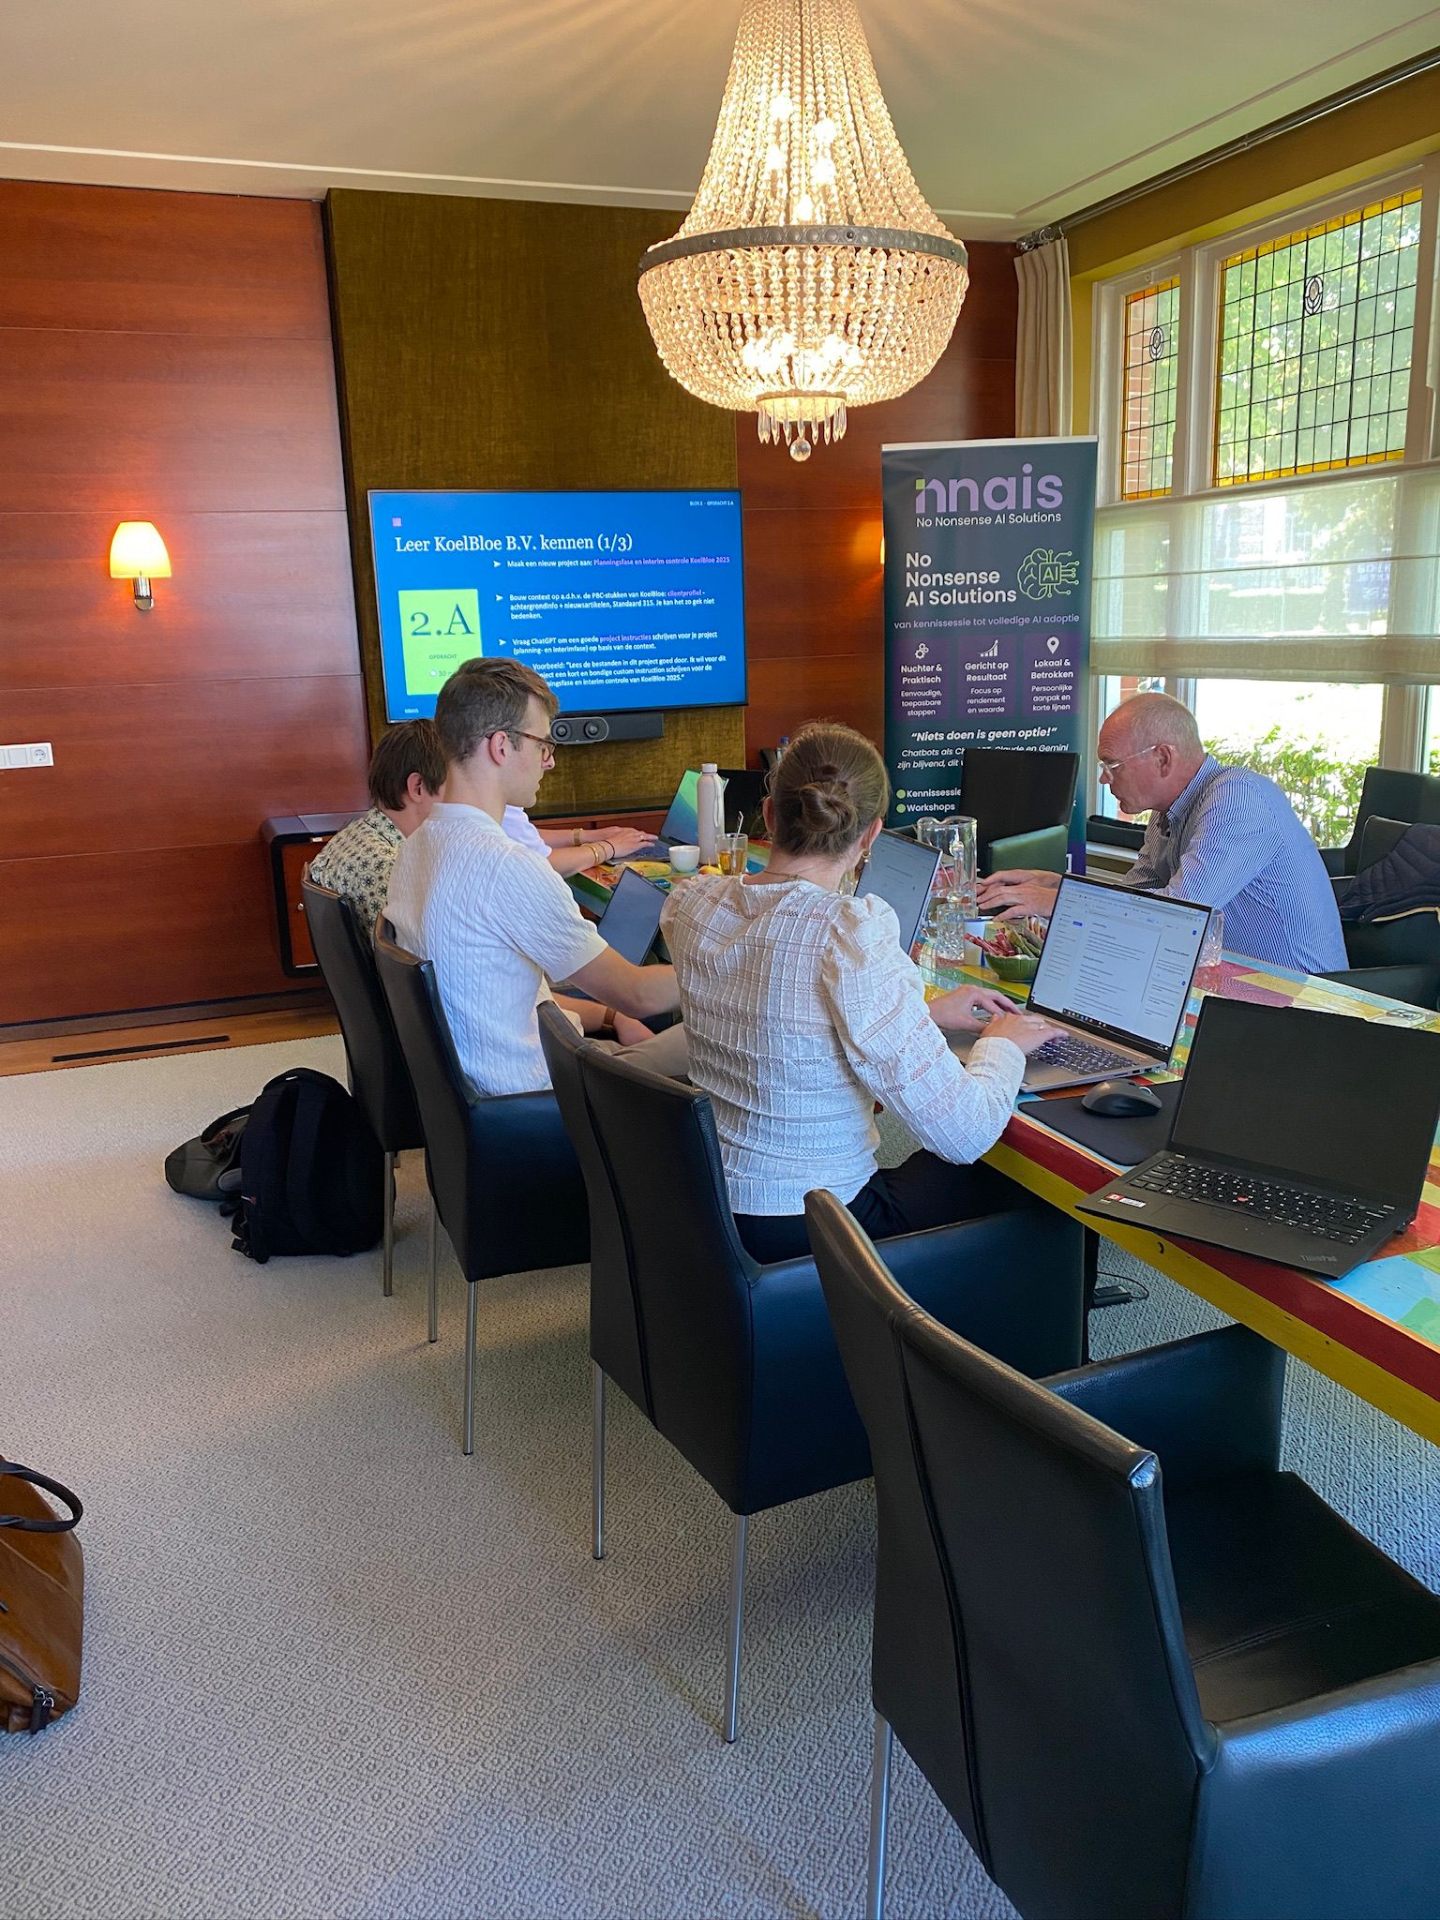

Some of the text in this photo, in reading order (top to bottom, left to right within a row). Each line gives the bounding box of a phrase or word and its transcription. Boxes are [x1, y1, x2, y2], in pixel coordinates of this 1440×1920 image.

[916, 513, 1061, 527] No Nonsense AI Solutions
[395, 533, 633, 552] Leer KoelBloe B.V. kennen (1/3)
[906, 552, 932, 568] No
[1042, 566, 1058, 581] AI
[906, 571, 1000, 587] Nonsense
[906, 588, 1016, 607] AI Solutions
[510, 602, 558, 611] achtergrondinfo
[693, 598, 702, 606] gek
[410, 603, 475, 636] 2.A
[894, 613, 1079, 629] van kennissessie tot volledige AI adoptie
[600, 635, 620, 643] project
[698, 631, 717, 639] project
[514, 646, 543, 655] (planning-
[901, 664, 934, 673] Nuchter
[965, 662, 1009, 671] Gericht op
[1034, 659, 1062, 668] Lokaal
[589, 668, 612, 677] bondige
[666, 665, 691, 673] schrijven
[1031, 670, 1074, 679] Betrokken
[902, 676, 941, 684] Praktisch
[966, 673, 1007, 682] Resultaat
[1032, 684, 1073, 692] Persoonlijke
[902, 700, 941, 708] toepasbare
[1052, 704, 1071, 712] lijnen
[947, 731, 975, 740] doen
[976, 729, 986, 739] is
[988, 730, 1016, 741] geen
[1039, 744, 1068, 752] Gemini
[897, 760, 911, 770] zijn
[913, 760, 945, 770] blijvend,
[907, 803, 955, 812] Workshops
